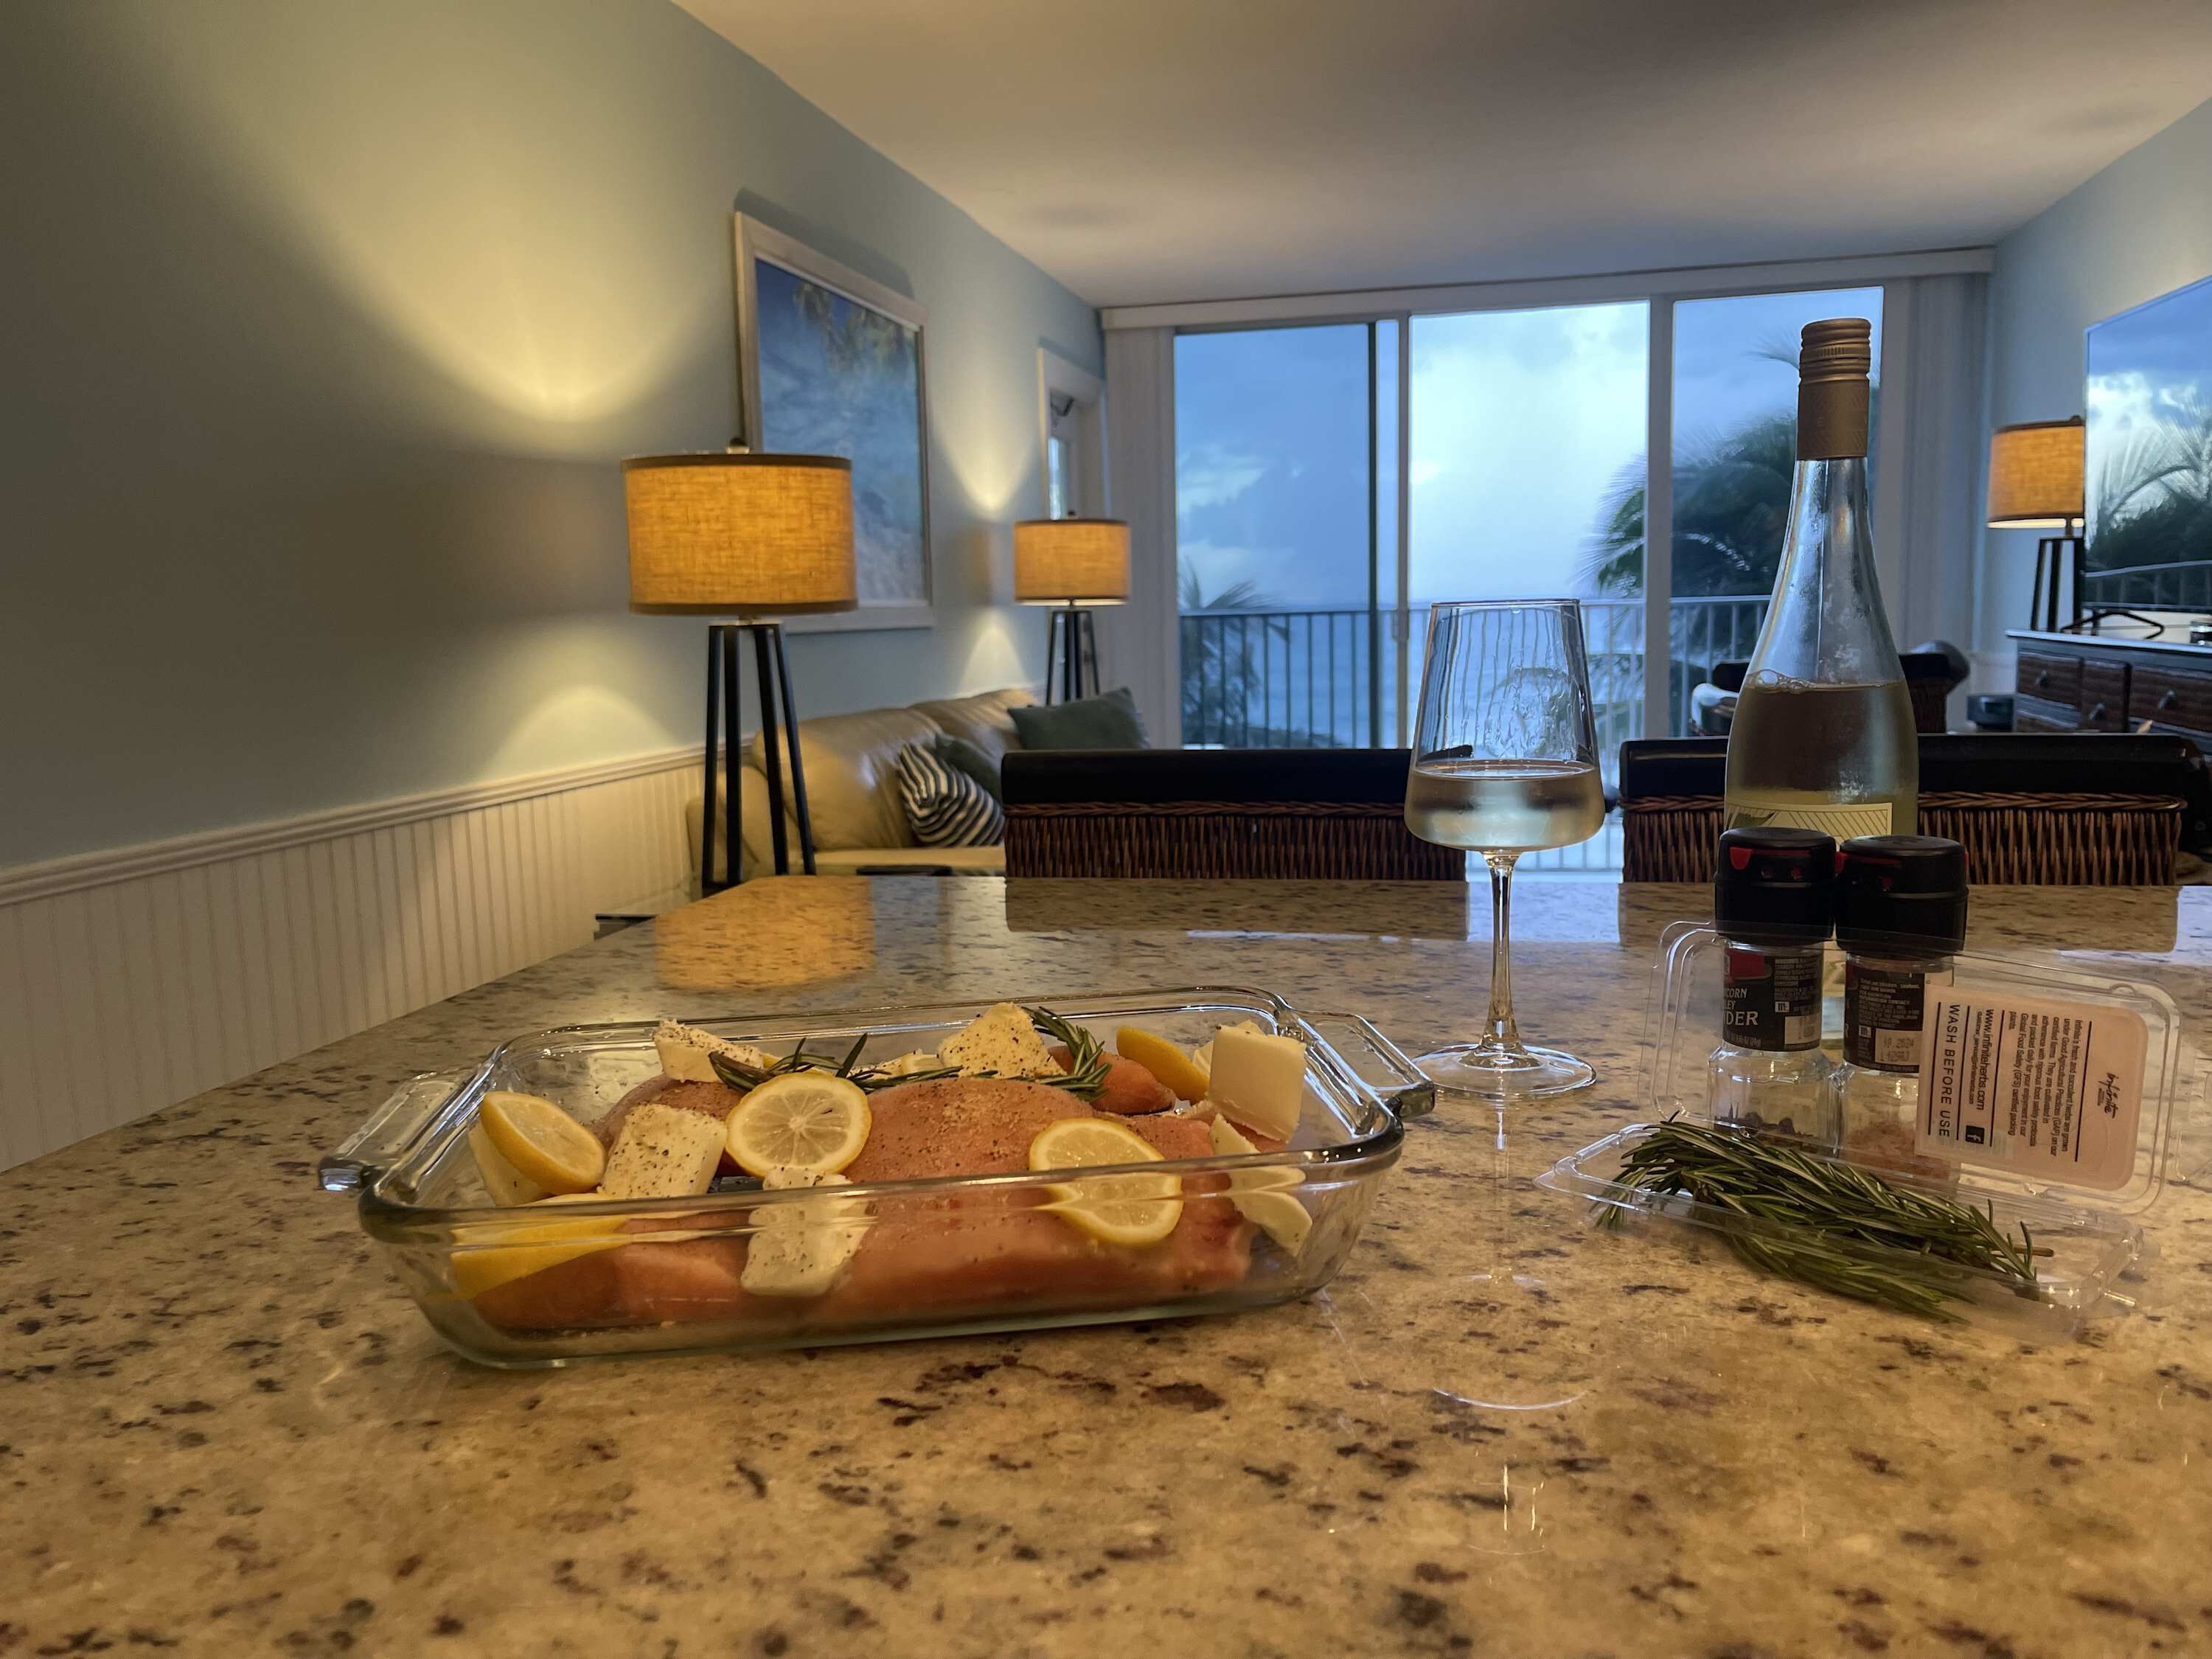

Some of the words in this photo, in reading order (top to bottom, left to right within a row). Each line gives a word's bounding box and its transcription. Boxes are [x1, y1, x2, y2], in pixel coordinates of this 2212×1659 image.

[1724, 987, 1747, 999] CORN
[1946, 1004, 1960, 1043] WASH
[2020, 1013, 2028, 1032] Global
[2039, 1015, 2049, 1046] adherence
[2051, 1017, 2060, 1040] certified
[2017, 1033, 2026, 1048] Food
[2028, 1026, 2037, 1048] packed
[2061, 1037, 2069, 1053] Good
[1976, 1009, 1994, 1110] www.infiniteherbs.com
[2013, 1049, 2024, 1068] Safety
[2025, 1049, 2034, 1062] daily
[1941, 1048, 1955, 1105] BEFORE
[2011, 1069, 2022, 1088] (GFS)
[2035, 1061, 2043, 1085] rigorous
[2045, 1062, 2056, 1076] They
[2056, 1053, 2067, 1088] Agricultural
[2034, 1086, 2042, 1099] food
[2066, 1074, 2075, 1103] succulent
[2097, 1072, 2120, 1119] infinite
[2011, 1088, 2020, 1112] certified
[2020, 1088, 2030, 1119] enjoyment
[2031, 1100, 2040, 1118] safety
[2042, 1088, 2052, 1116] cultivated
[2054, 1088, 2064, 1116] Practices
[2065, 1103, 2073, 1121] herbs
[1938, 1110, 1951, 1137] USE
[2007, 1113, 2017, 1135] packing
[2029, 1119, 2038, 1147] protocols
[2051, 1117, 2061, 1136] (GAP)
[2061, 1133, 2069, 1152] grown
